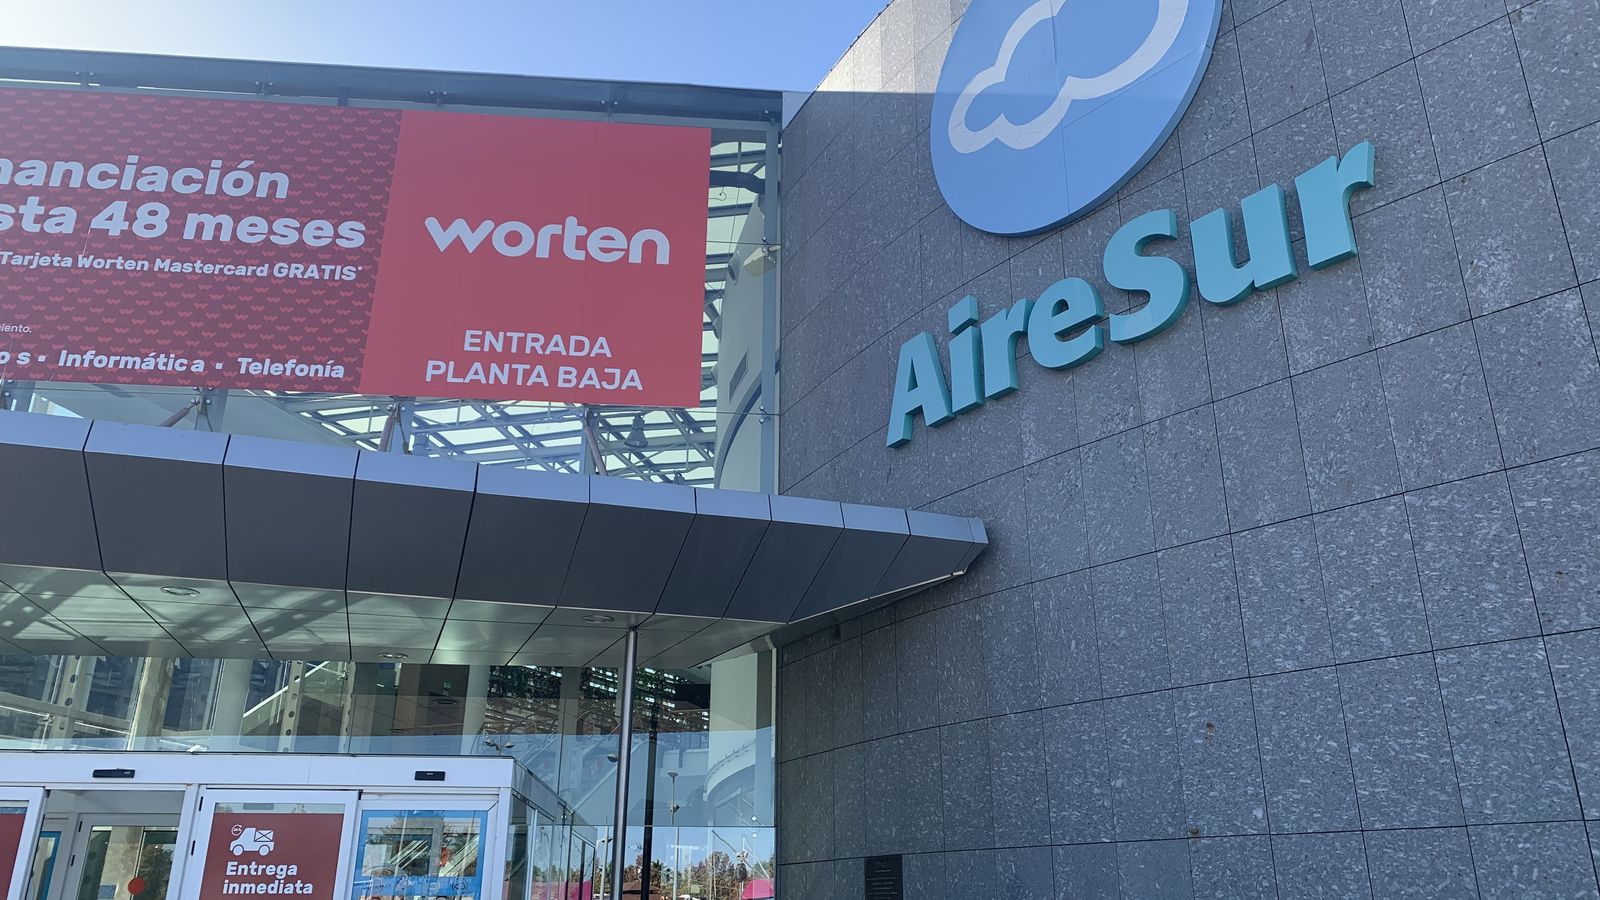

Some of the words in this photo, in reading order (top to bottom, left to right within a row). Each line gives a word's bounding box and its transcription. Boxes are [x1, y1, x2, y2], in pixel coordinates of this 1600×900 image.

[90, 201, 169, 238] 48
[183, 211, 366, 248] meses
[424, 216, 670, 264] worten
[0, 251, 73, 269] Tarjeta
[77, 255, 149, 271] Worten
[153, 258, 269, 277] Mastercard
[886, 141, 1375, 448] AireSur
[0, 323, 32, 333] iento.
[464, 330, 612, 358] ENTRADA
[58, 349, 205, 373] Informática
[237, 357, 345, 378] Telefonía
[425, 360, 549, 387] PLANTA
[557, 366, 643, 390] BAJA
[225, 861, 298, 880] Entrega
[222, 880, 314, 895] inmediata
